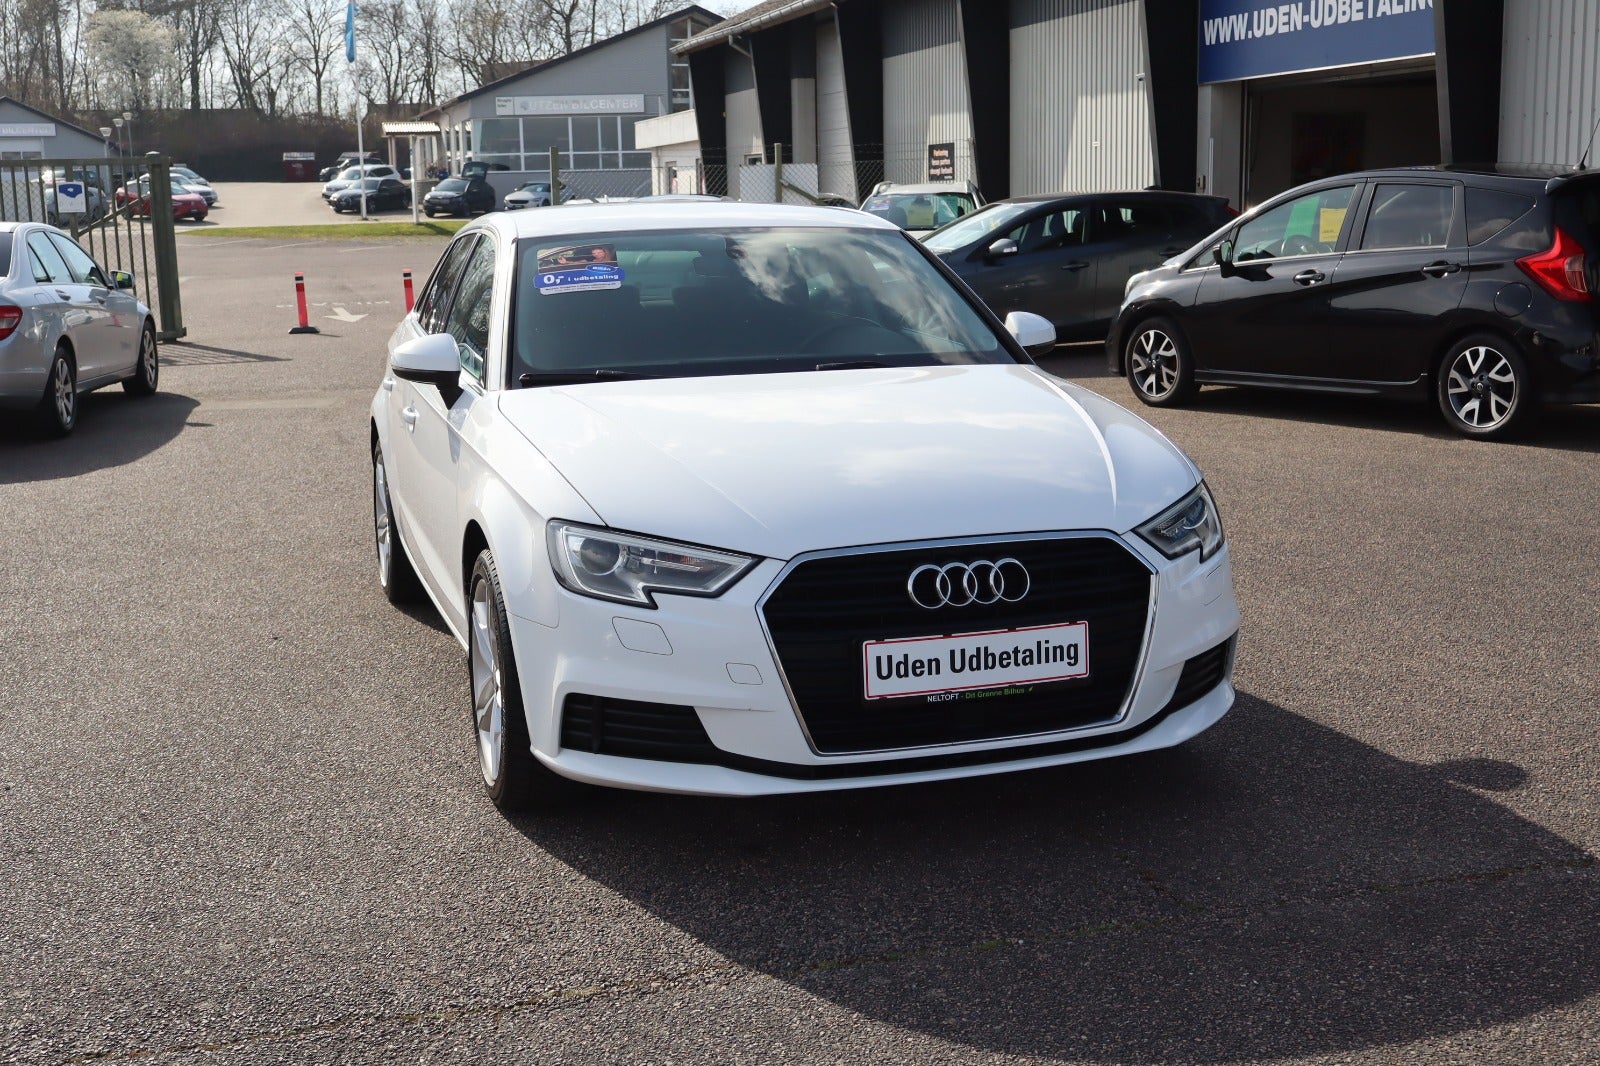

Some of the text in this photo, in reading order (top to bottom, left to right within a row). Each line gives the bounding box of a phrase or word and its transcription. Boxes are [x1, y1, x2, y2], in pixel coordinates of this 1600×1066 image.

[571, 98, 638, 110] BILCENTER
[875, 639, 1079, 681] Uden Udbetaling
[927, 692, 960, 703] NELTOFT
[1004, 687, 1025, 696] Bilhus
